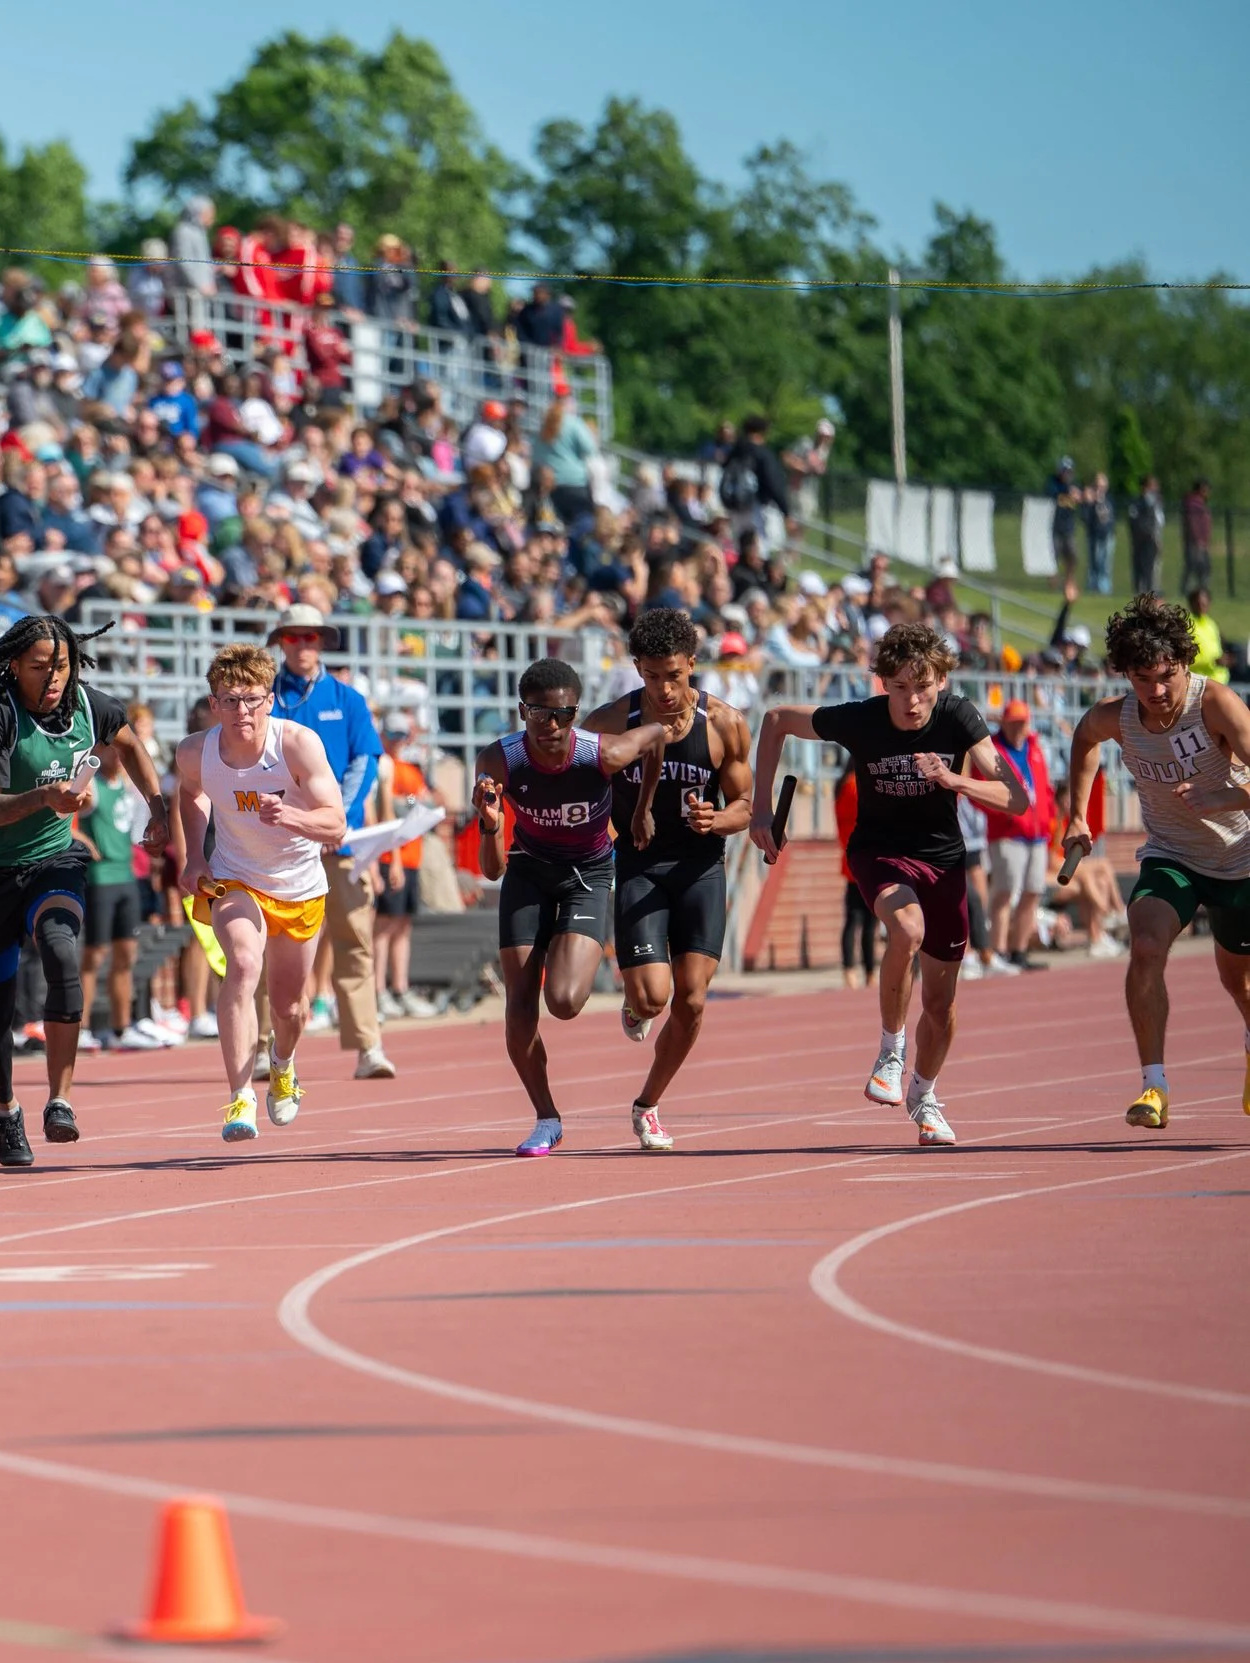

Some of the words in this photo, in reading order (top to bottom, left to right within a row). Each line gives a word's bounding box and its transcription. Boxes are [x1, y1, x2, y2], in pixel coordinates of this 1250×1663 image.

[1174, 732, 1206, 759] 11
[623, 761, 711, 784] LAEVIEW
[867, 760, 919, 774] DETRO
[567, 805, 587, 824] 8
